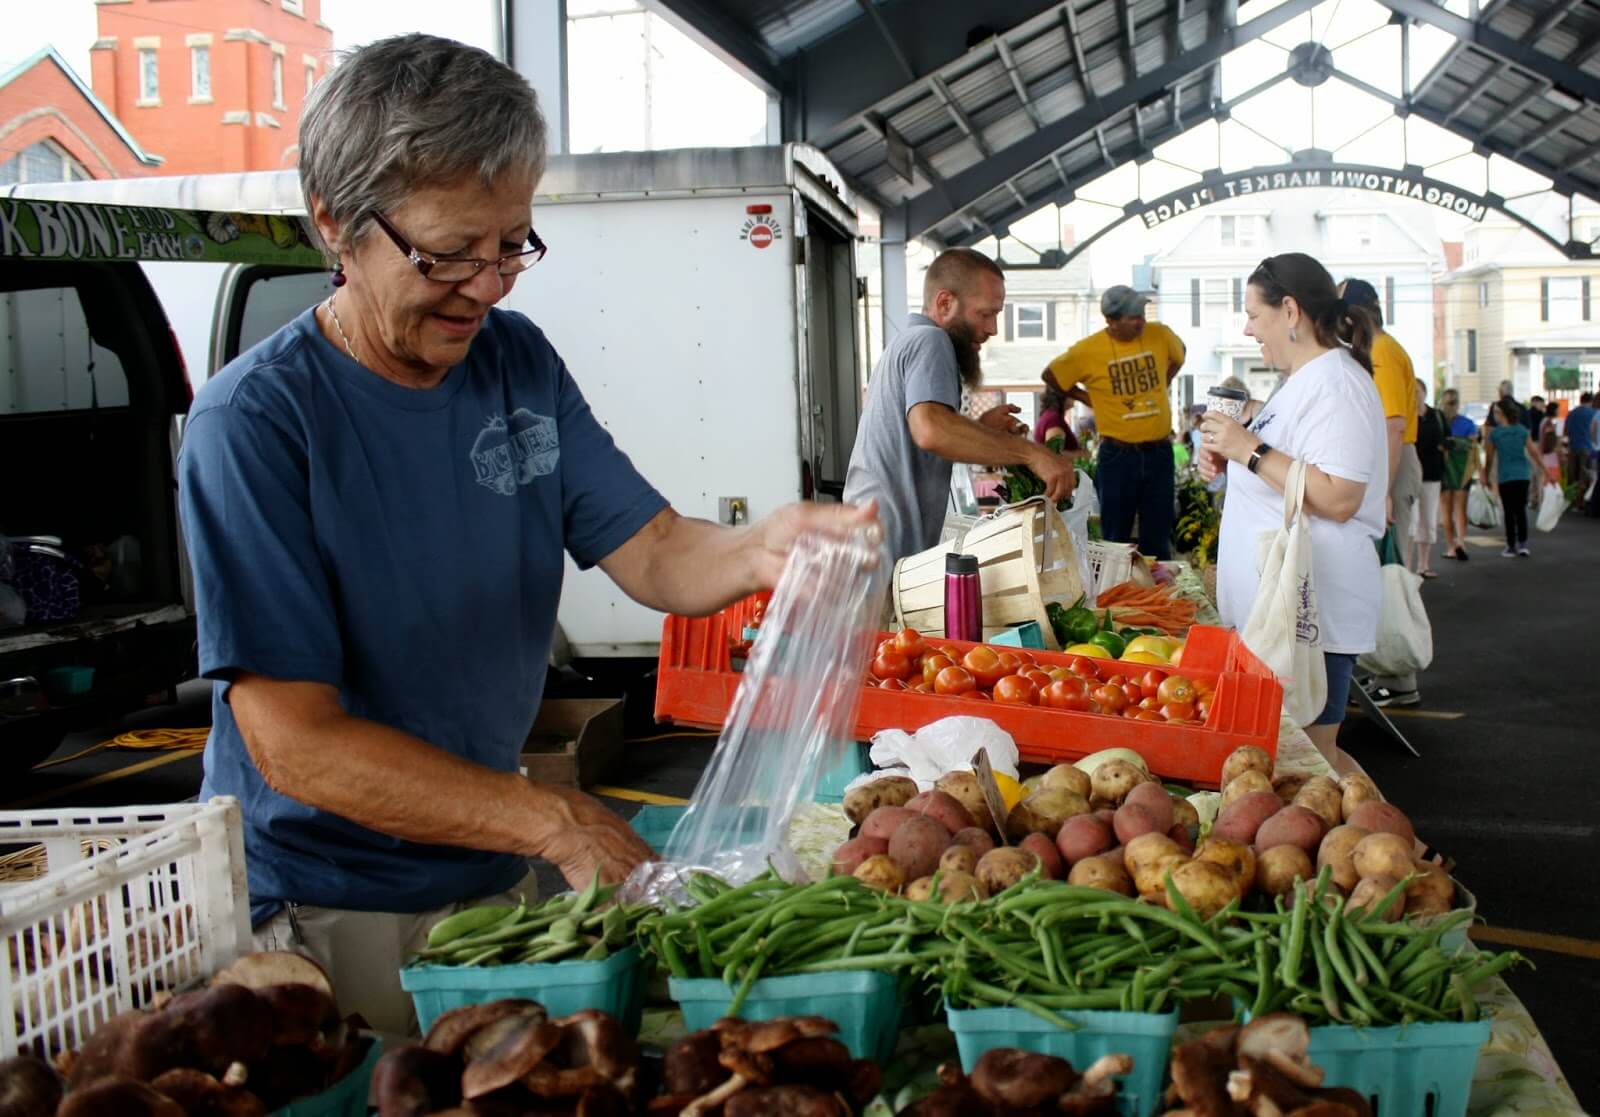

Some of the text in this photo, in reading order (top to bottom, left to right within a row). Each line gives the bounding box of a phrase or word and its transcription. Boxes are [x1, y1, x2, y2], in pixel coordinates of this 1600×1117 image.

[27, 201, 134, 258] BONE
[1108, 354, 1156, 379] GOLD
[1110, 371, 1159, 396] RUSH
